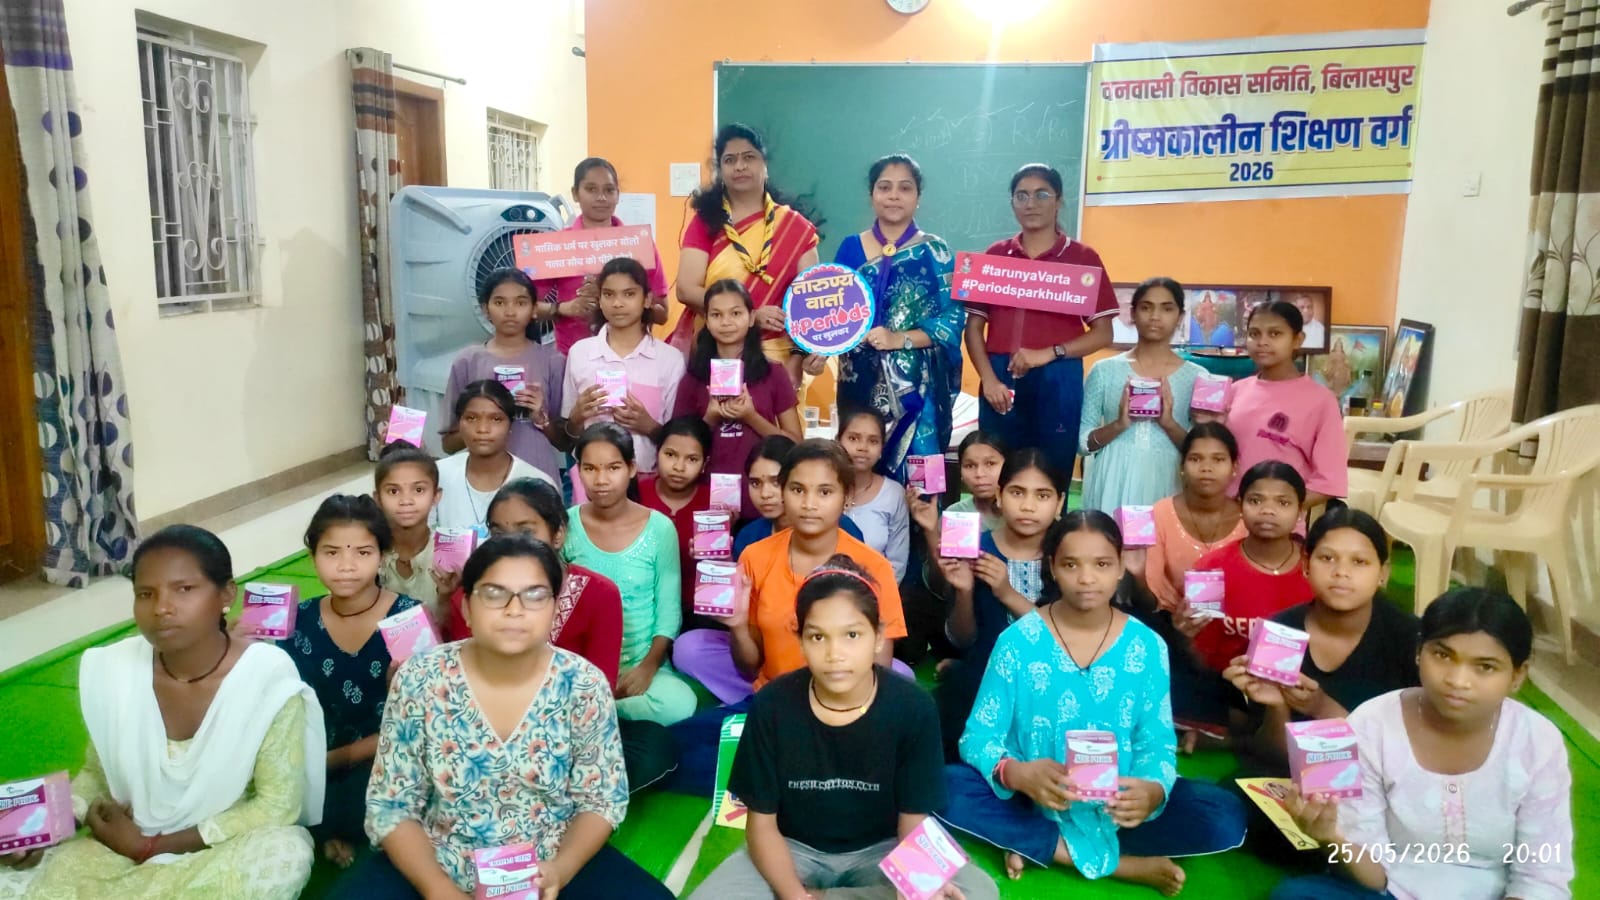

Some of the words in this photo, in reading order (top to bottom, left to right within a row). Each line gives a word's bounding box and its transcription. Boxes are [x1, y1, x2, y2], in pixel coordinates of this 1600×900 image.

[1099, 72, 1174, 101] वनवासी
[1179, 71, 1242, 98] विकास
[1246, 64, 1317, 95] समिति,
[1321, 63, 1416, 94] बिलासपुर
[1100, 113, 1265, 161] ग्रीष्मकालीन
[1269, 111, 1364, 153] शिक्षण
[1369, 105, 1414, 148] वर्ग
[1229, 161, 1274, 183] 2026
[578, 241, 588, 250] पर
[585, 255, 597, 266] को
[792, 273, 855, 297] तारुण्य
[981, 262, 1072, 287] #tarunyaVarta
[805, 289, 846, 311] वार्ता
[961, 277, 1088, 306] #Periodsparkhulkar
[790, 303, 872, 338] #Periods
[812, 332, 823, 343] पर
